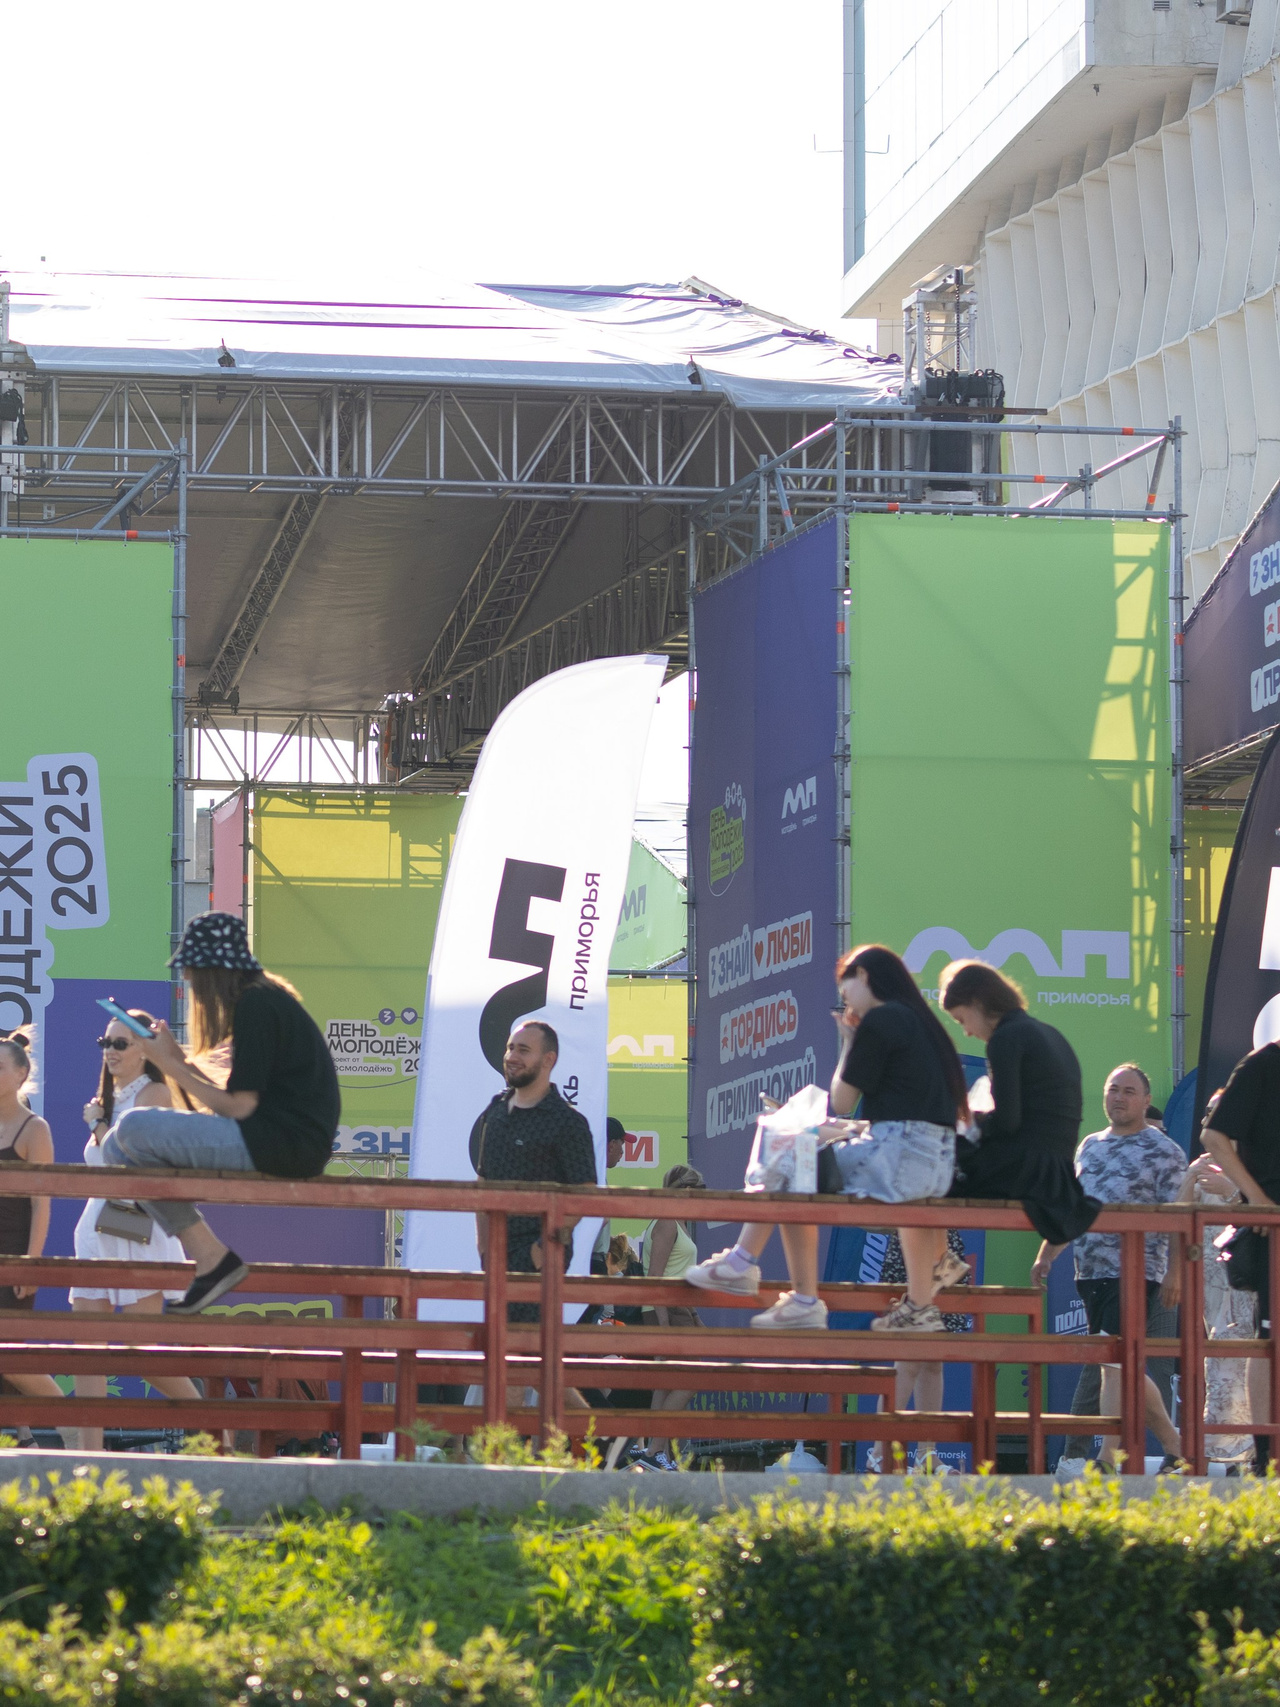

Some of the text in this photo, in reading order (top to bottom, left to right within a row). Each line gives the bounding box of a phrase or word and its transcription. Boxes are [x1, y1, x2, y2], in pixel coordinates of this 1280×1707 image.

[41, 764, 98, 917] 2025
[569, 872, 601, 1011] приморья
[718, 918, 811, 986] ЗНАЙ ЛЮБИ
[1037, 991, 1131, 1006] приморья
[327, 1023, 377, 1039] ДЕНЬ
[730, 998, 797, 1051] ГОРДИСЬ
[328, 1037, 421, 1056] МОЛОДЁЖ
[334, 1065, 393, 1073] осмолодёжь
